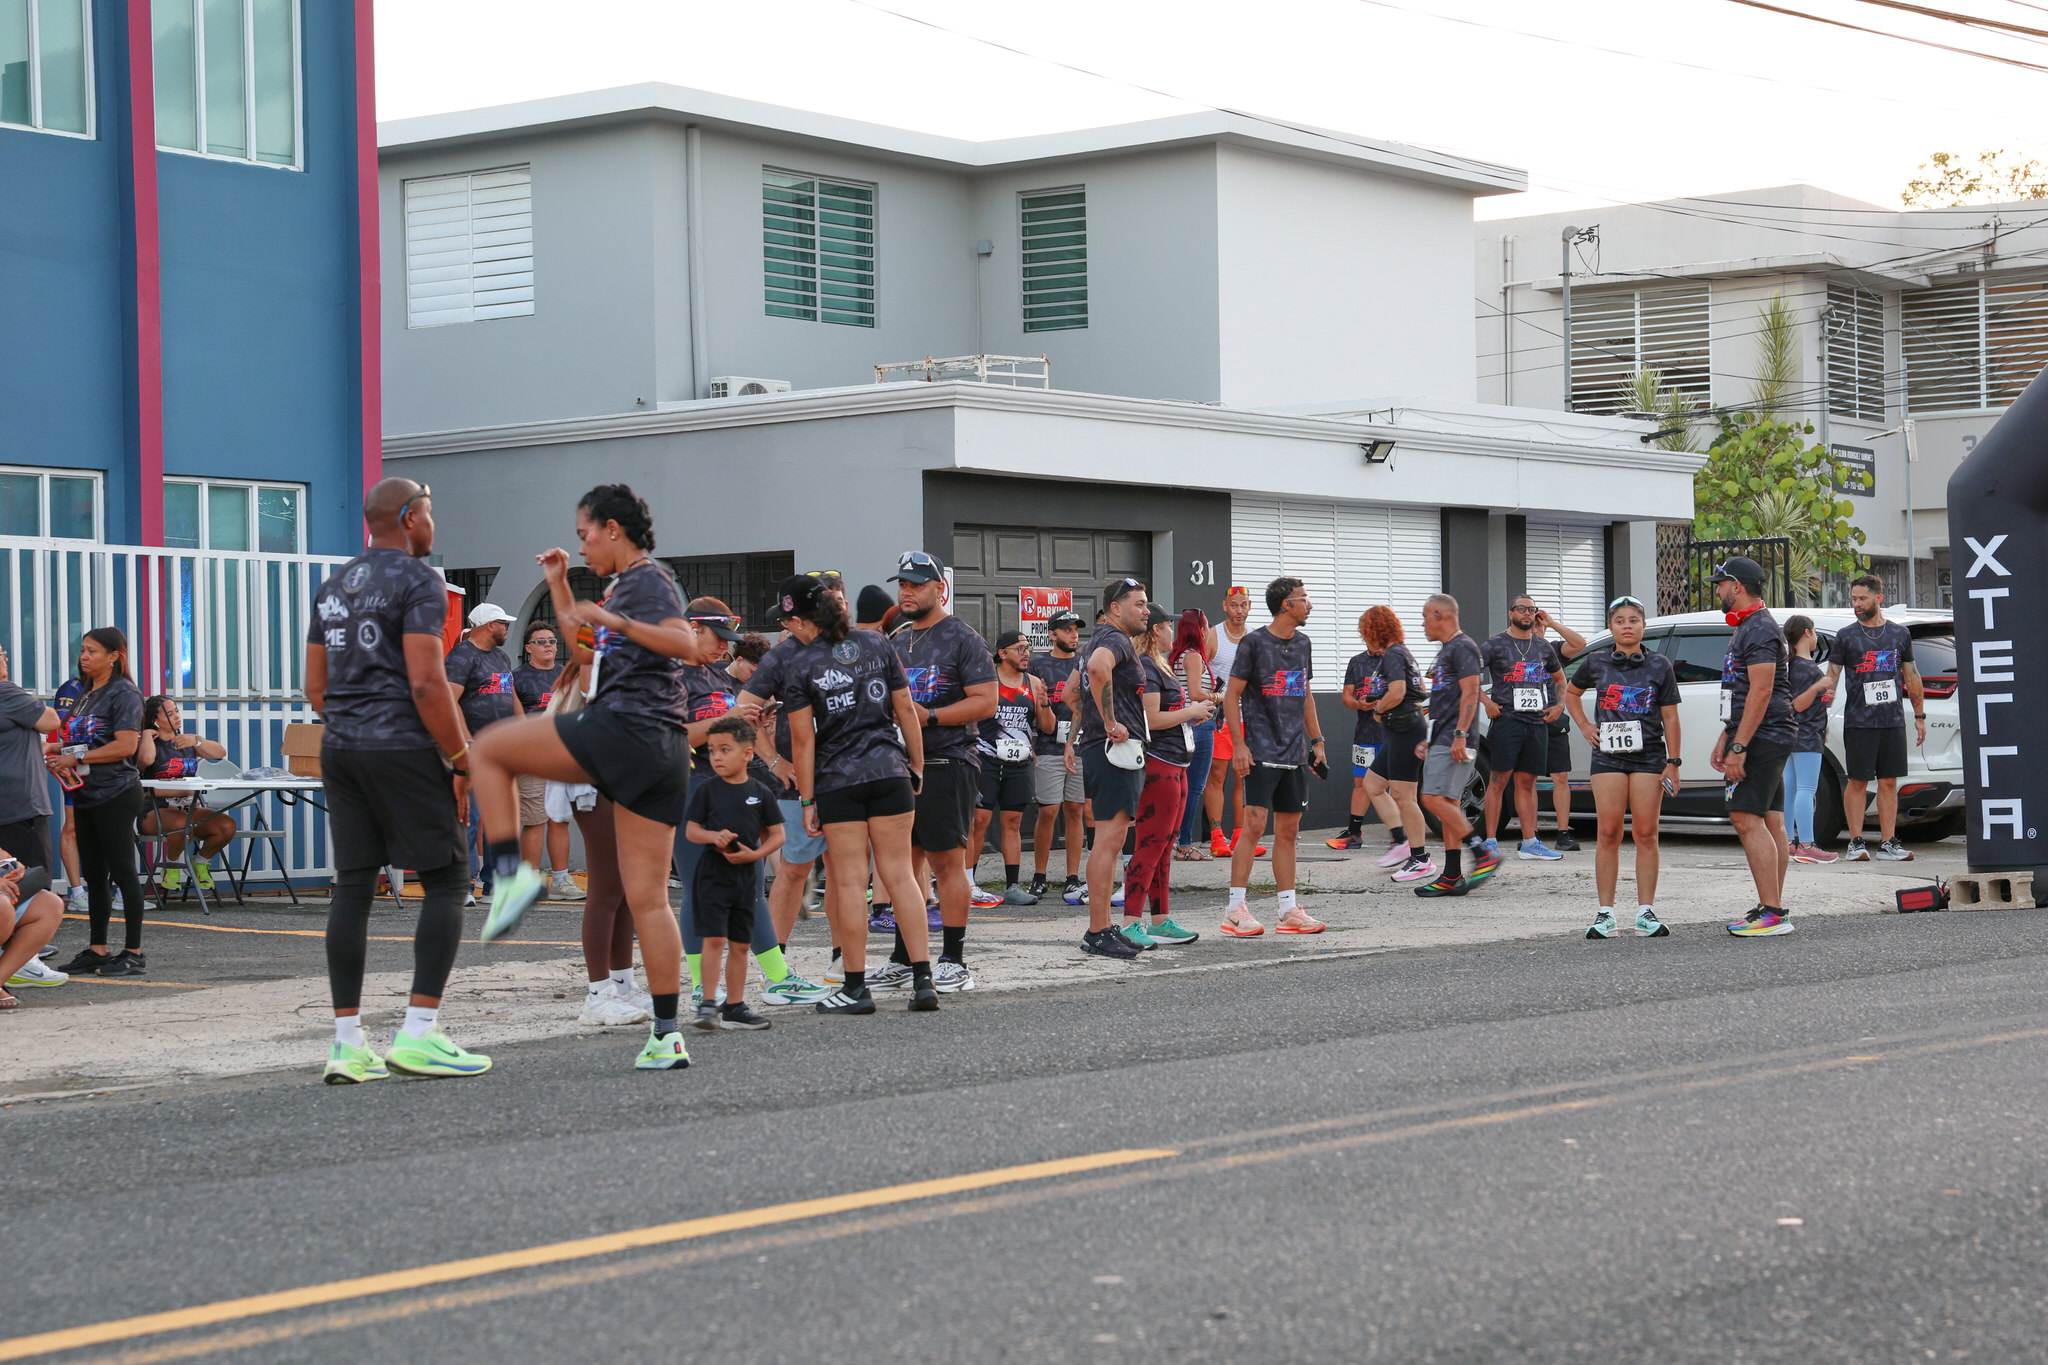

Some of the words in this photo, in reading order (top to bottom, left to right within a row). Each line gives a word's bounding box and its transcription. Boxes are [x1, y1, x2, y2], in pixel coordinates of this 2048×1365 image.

[1190, 560, 1215, 586] 31
[1047, 592, 1059, 605] NO
[1864, 650, 1894, 666] 5K
[1512, 662, 1541, 676] 5K
[490, 672, 511, 688] 5K
[1272, 670, 1303, 689] 5K
[1261, 688, 1284, 696] FADE
[1604, 684, 1647, 705] 5K
[1875, 690, 1888, 701] 89
[826, 690, 856, 711] EME
[1521, 698, 1538, 708] 223
[1608, 735, 1633, 748] 116
[1007, 748, 1020, 759] 34
[1355, 754, 1366, 765] 56
[166, 757, 196, 773] 5K
